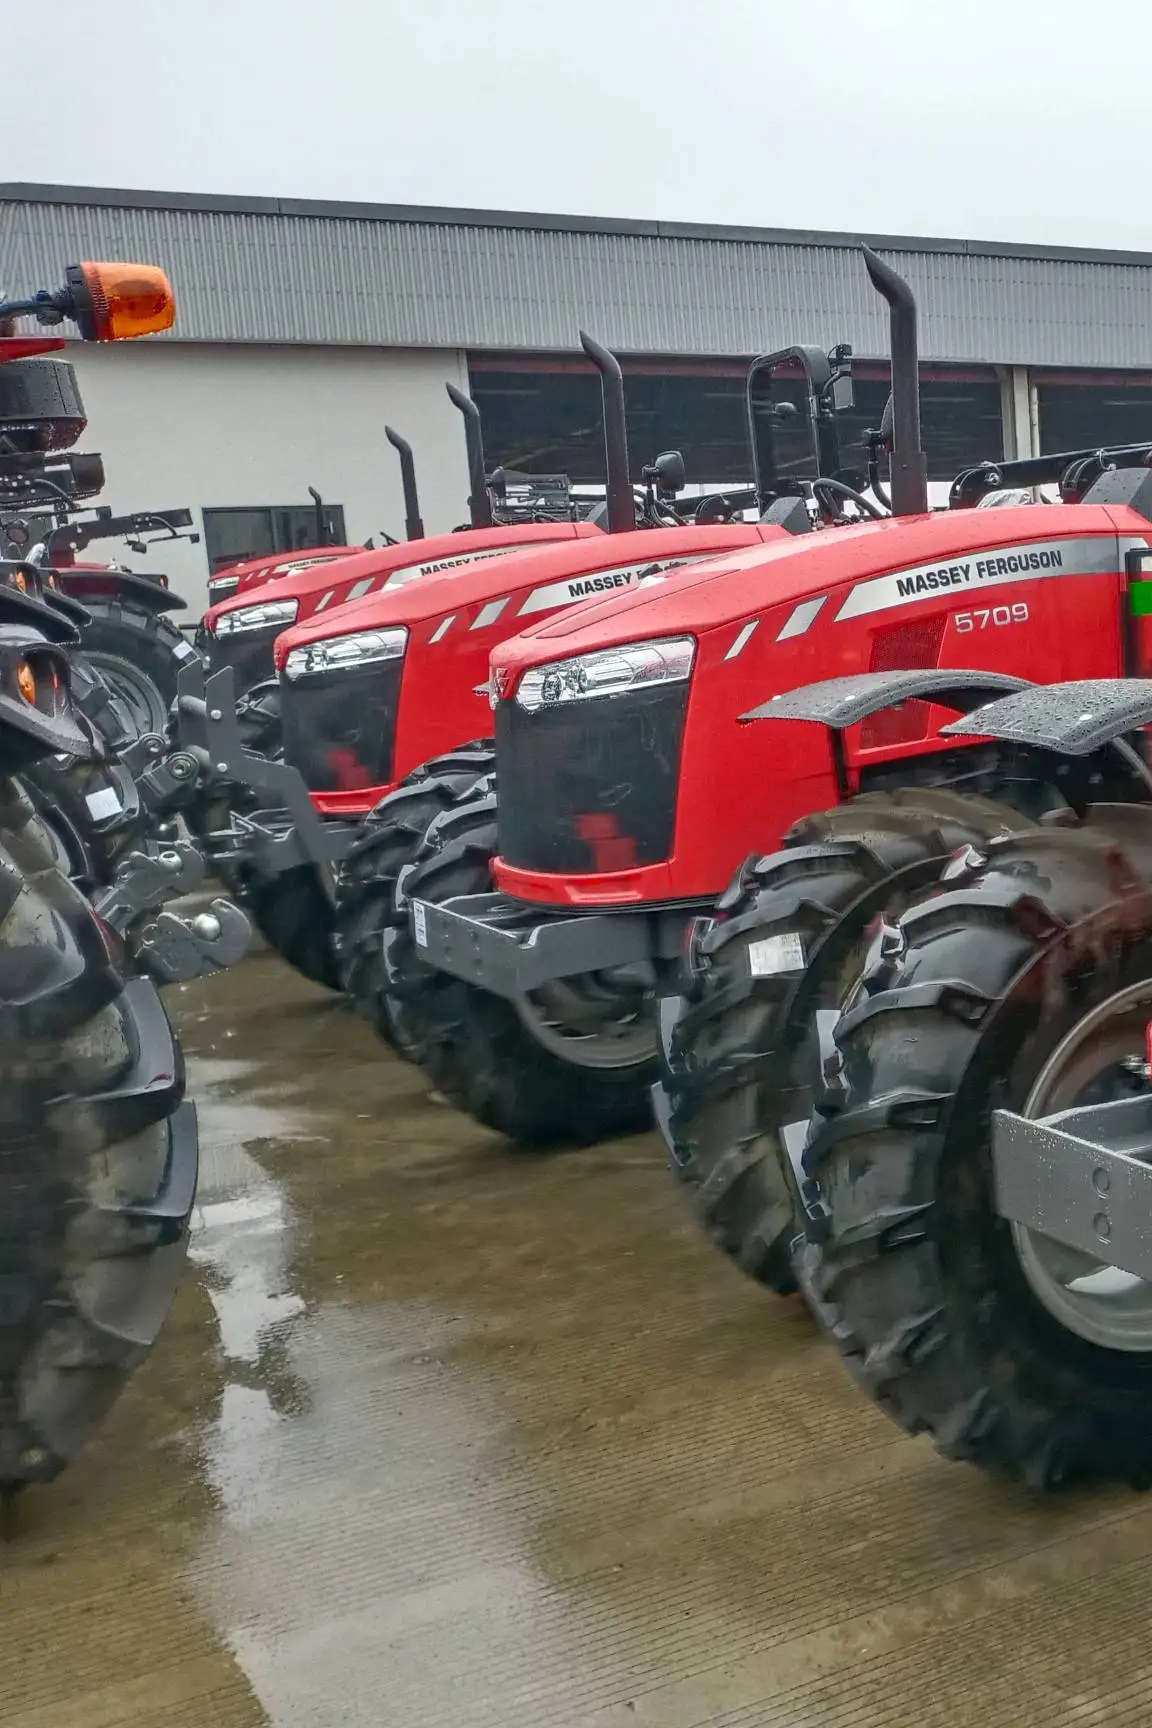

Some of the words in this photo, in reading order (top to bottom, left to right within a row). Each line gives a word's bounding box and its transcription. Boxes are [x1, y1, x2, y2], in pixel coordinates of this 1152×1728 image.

[568, 572, 632, 597] MASSEY
[896, 564, 971, 597] MASSEY
[976, 550, 1063, 578] FERGUSON
[955, 602, 1029, 633] 5709
